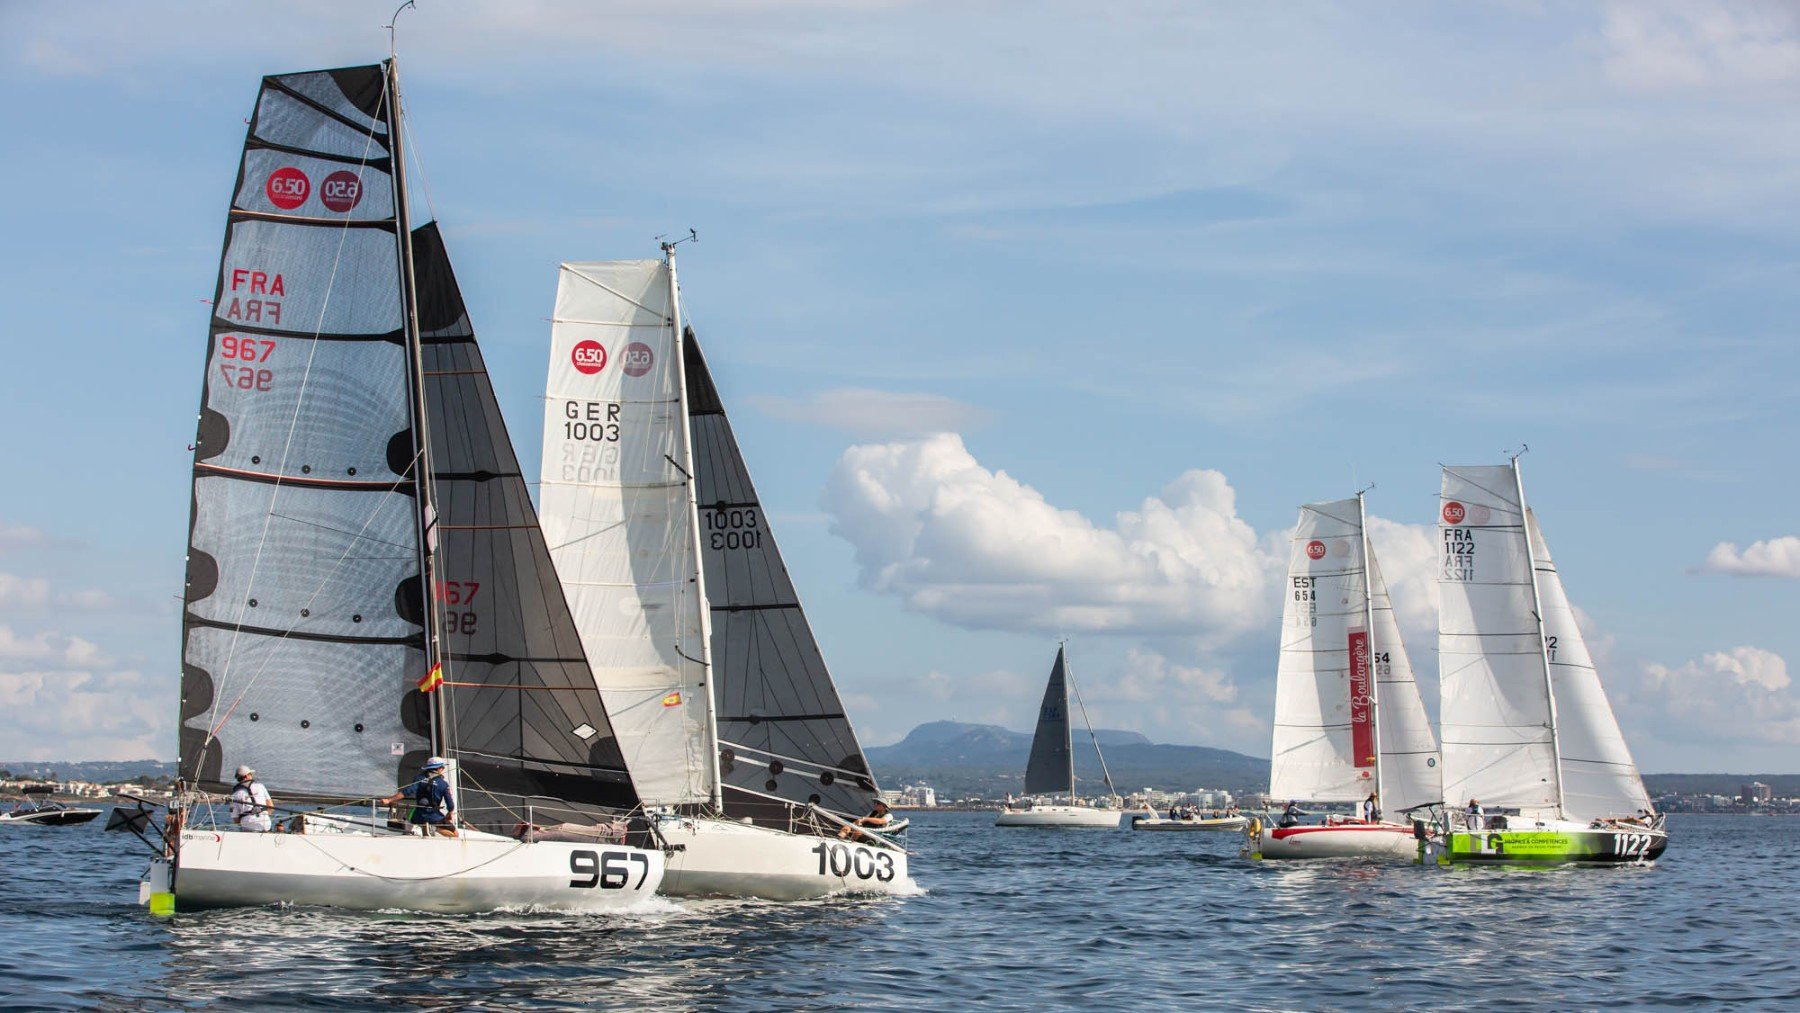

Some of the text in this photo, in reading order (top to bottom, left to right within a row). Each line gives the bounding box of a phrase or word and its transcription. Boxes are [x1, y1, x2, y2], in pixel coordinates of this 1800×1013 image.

[271, 178, 306, 196] 6.50
[231, 269, 285, 297] FRA
[221, 336, 276, 363] 967
[574, 348, 604, 363] 6.50
[565, 401, 621, 422] GER
[564, 422, 620, 442] 1003
[705, 510, 757, 531] 1003
[1444, 529, 1473, 541] FRA
[1444, 542, 1475, 554] 1122
[1293, 577, 1317, 588] EST
[1294, 590, 1316, 601] 654
[1613, 833, 1652, 857] 1122
[569, 850, 649, 891] 967
[812, 842, 895, 882] 1003
